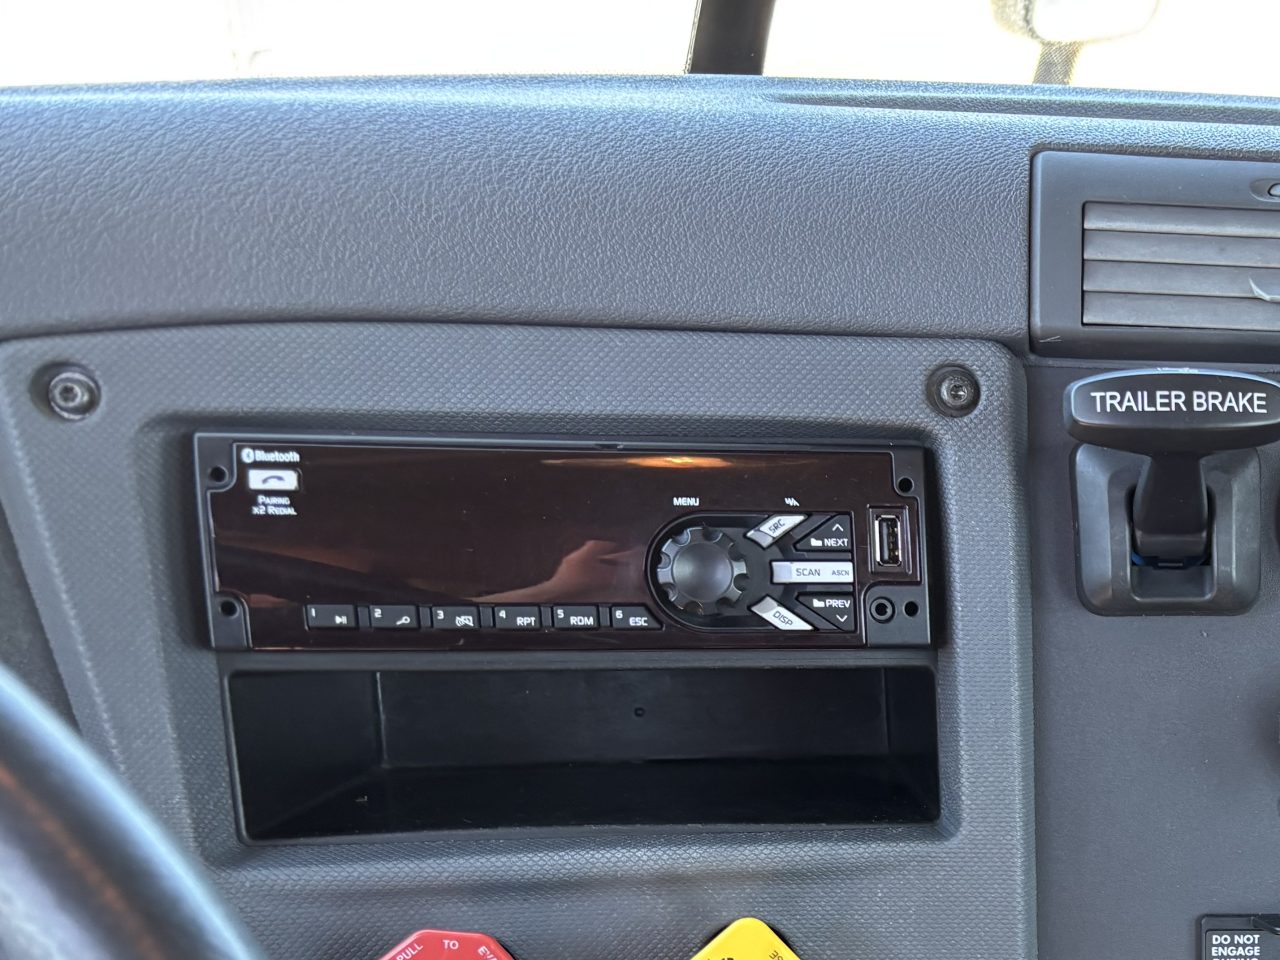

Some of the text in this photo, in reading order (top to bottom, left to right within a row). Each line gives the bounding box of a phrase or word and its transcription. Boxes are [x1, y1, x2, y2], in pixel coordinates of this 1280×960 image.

[1090, 390, 1267, 414] TRAILER BRAKE
[254, 449, 300, 462] Bluetooth
[673, 497, 699, 506] MENU
[768, 519, 786, 534] SRC
[824, 538, 848, 547] NEXT
[796, 568, 821, 577] SCAN
[825, 600, 851, 608] PREV
[311, 608, 316, 617] 1
[374, 609, 382, 617] 2
[437, 610, 444, 619] 3
[499, 610, 506, 619] 4
[557, 609, 564, 618] 5
[616, 610, 623, 619] 6
[516, 617, 536, 626] RPT
[570, 616, 594, 625] RDM
[629, 617, 648, 626] ESC
[772, 611, 793, 626] DISP
[1212, 934, 1260, 944] DO NOT
[442, 939, 459, 950] TO
[1211, 947, 1260, 956] ENGAGE
